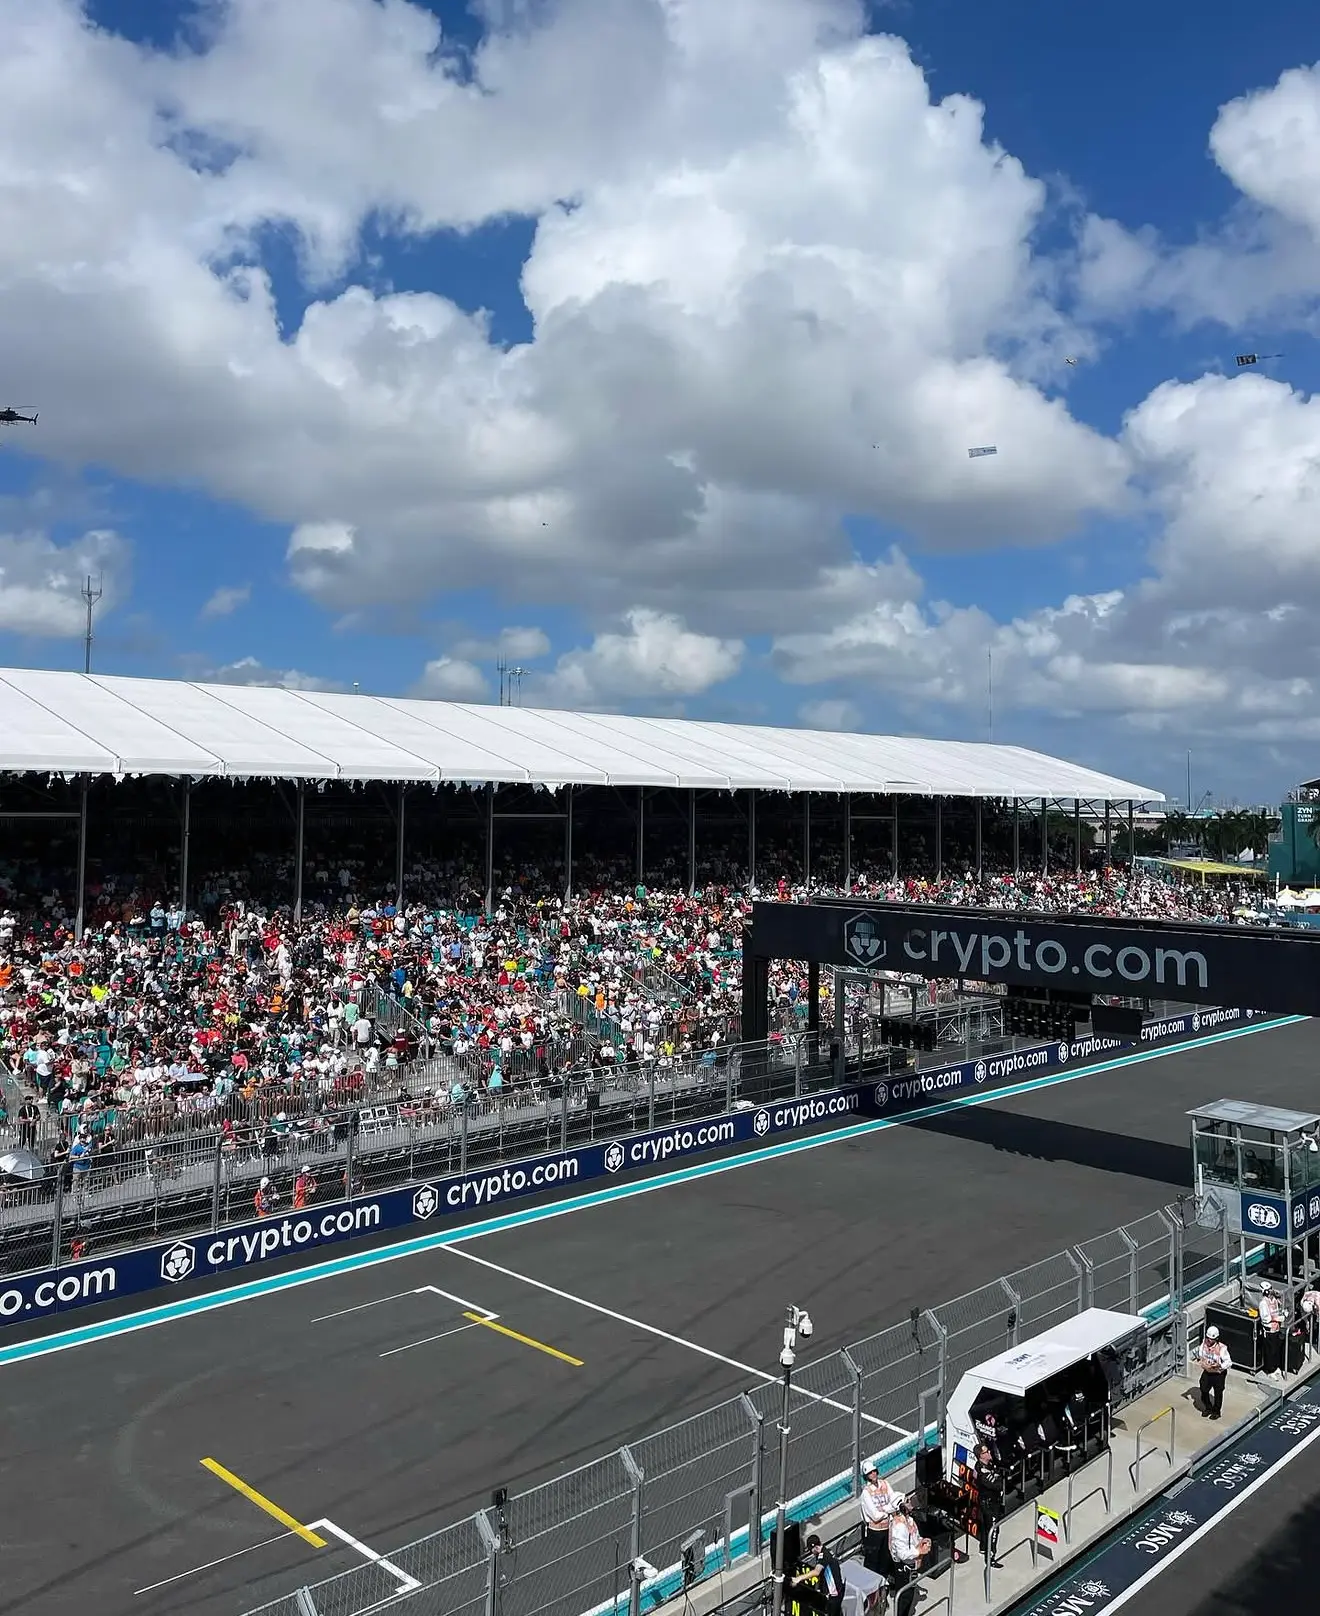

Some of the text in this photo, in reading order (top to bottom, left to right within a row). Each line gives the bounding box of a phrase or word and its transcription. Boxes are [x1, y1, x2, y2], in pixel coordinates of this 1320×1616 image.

[903, 928, 1209, 989] crypto.com
[1141, 1019, 1185, 1041] crypto.com
[1201, 1007, 1240, 1028] crypto.com
[989, 1049, 1048, 1077] crypto.com
[892, 1068, 962, 1099] crypto.com
[774, 1092, 859, 1126] crypto.com
[630, 1120, 735, 1161] crypto.com
[446, 1156, 579, 1206] crypto.com
[1250, 1204, 1280, 1227] FIA
[1293, 1205, 1305, 1227] FIA
[206, 1203, 381, 1264] crypto.com
[1213, 1462, 1256, 1490] MSC
[1135, 1521, 1183, 1554] MSC
